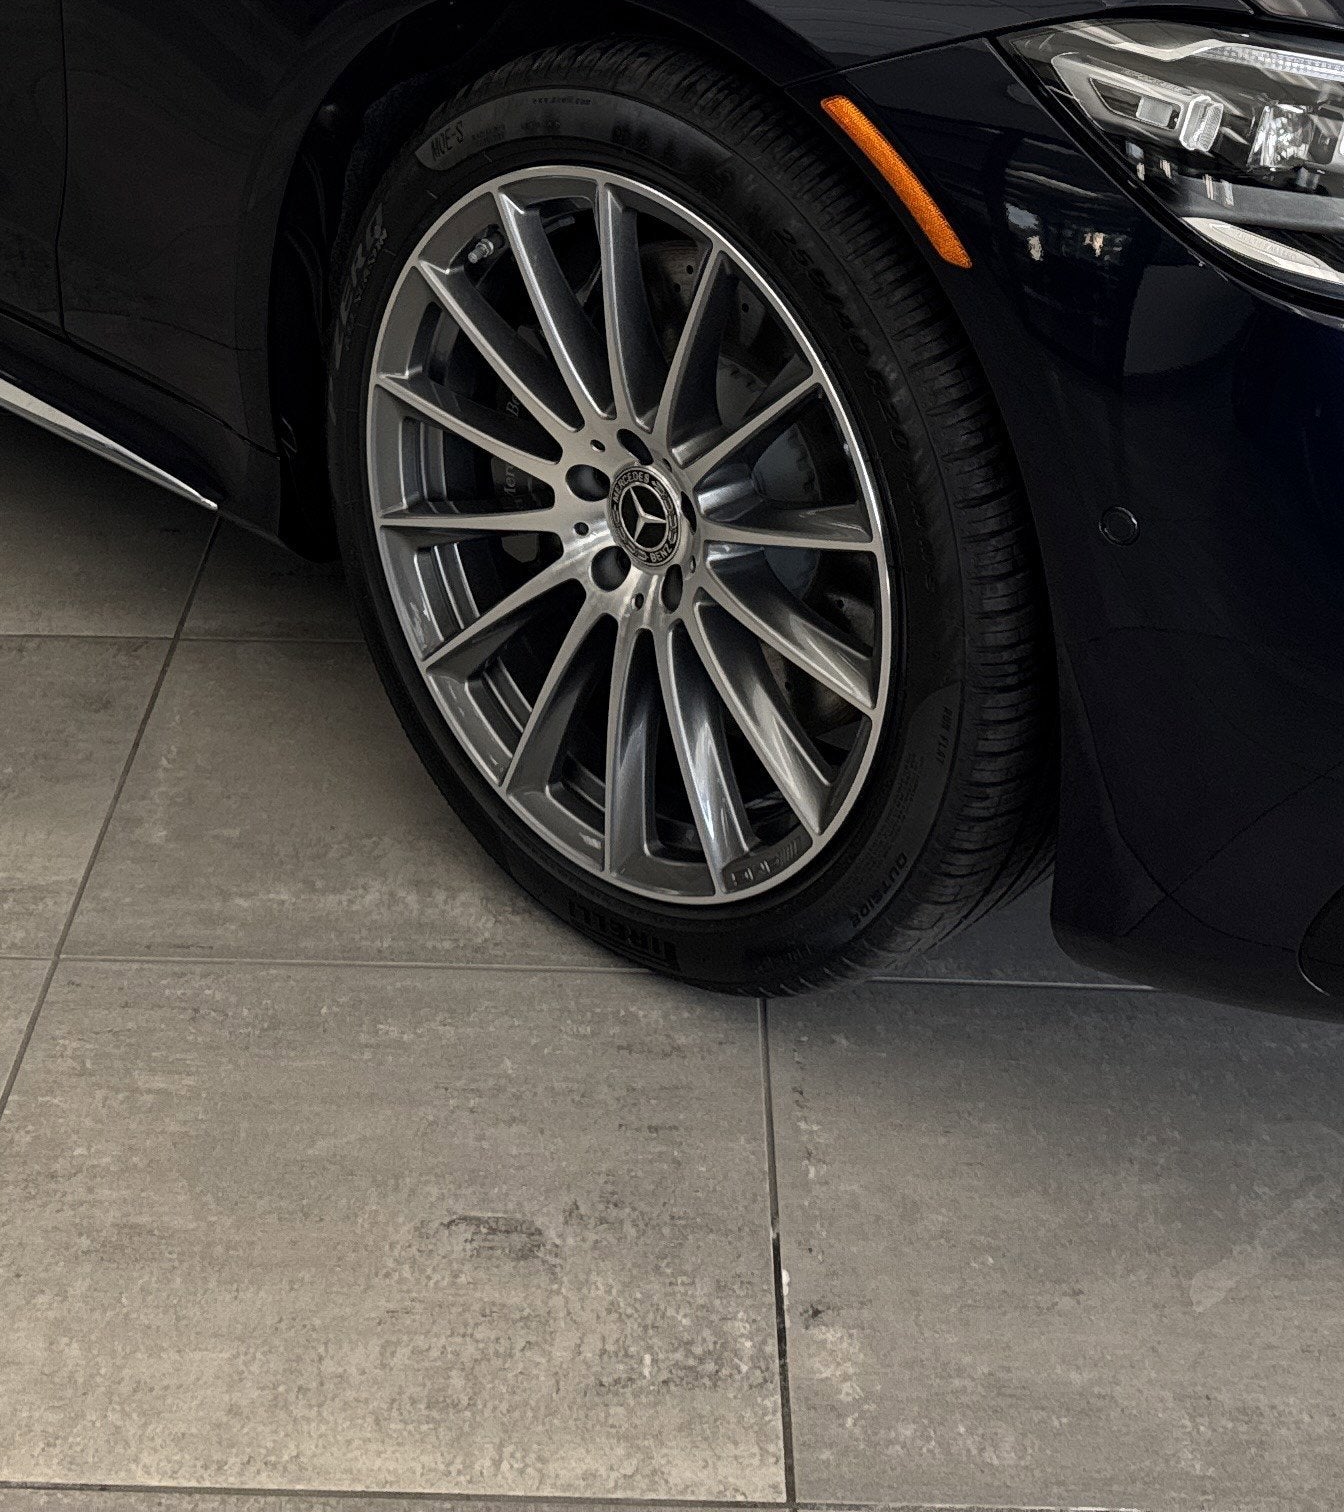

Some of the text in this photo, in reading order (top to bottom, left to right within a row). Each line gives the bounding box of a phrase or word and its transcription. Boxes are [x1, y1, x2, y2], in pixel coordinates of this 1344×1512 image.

[612, 471, 651, 504] MERCEDES
[649, 543, 674, 563] BENZ
[848, 852, 908, 929] OUTSIDE
